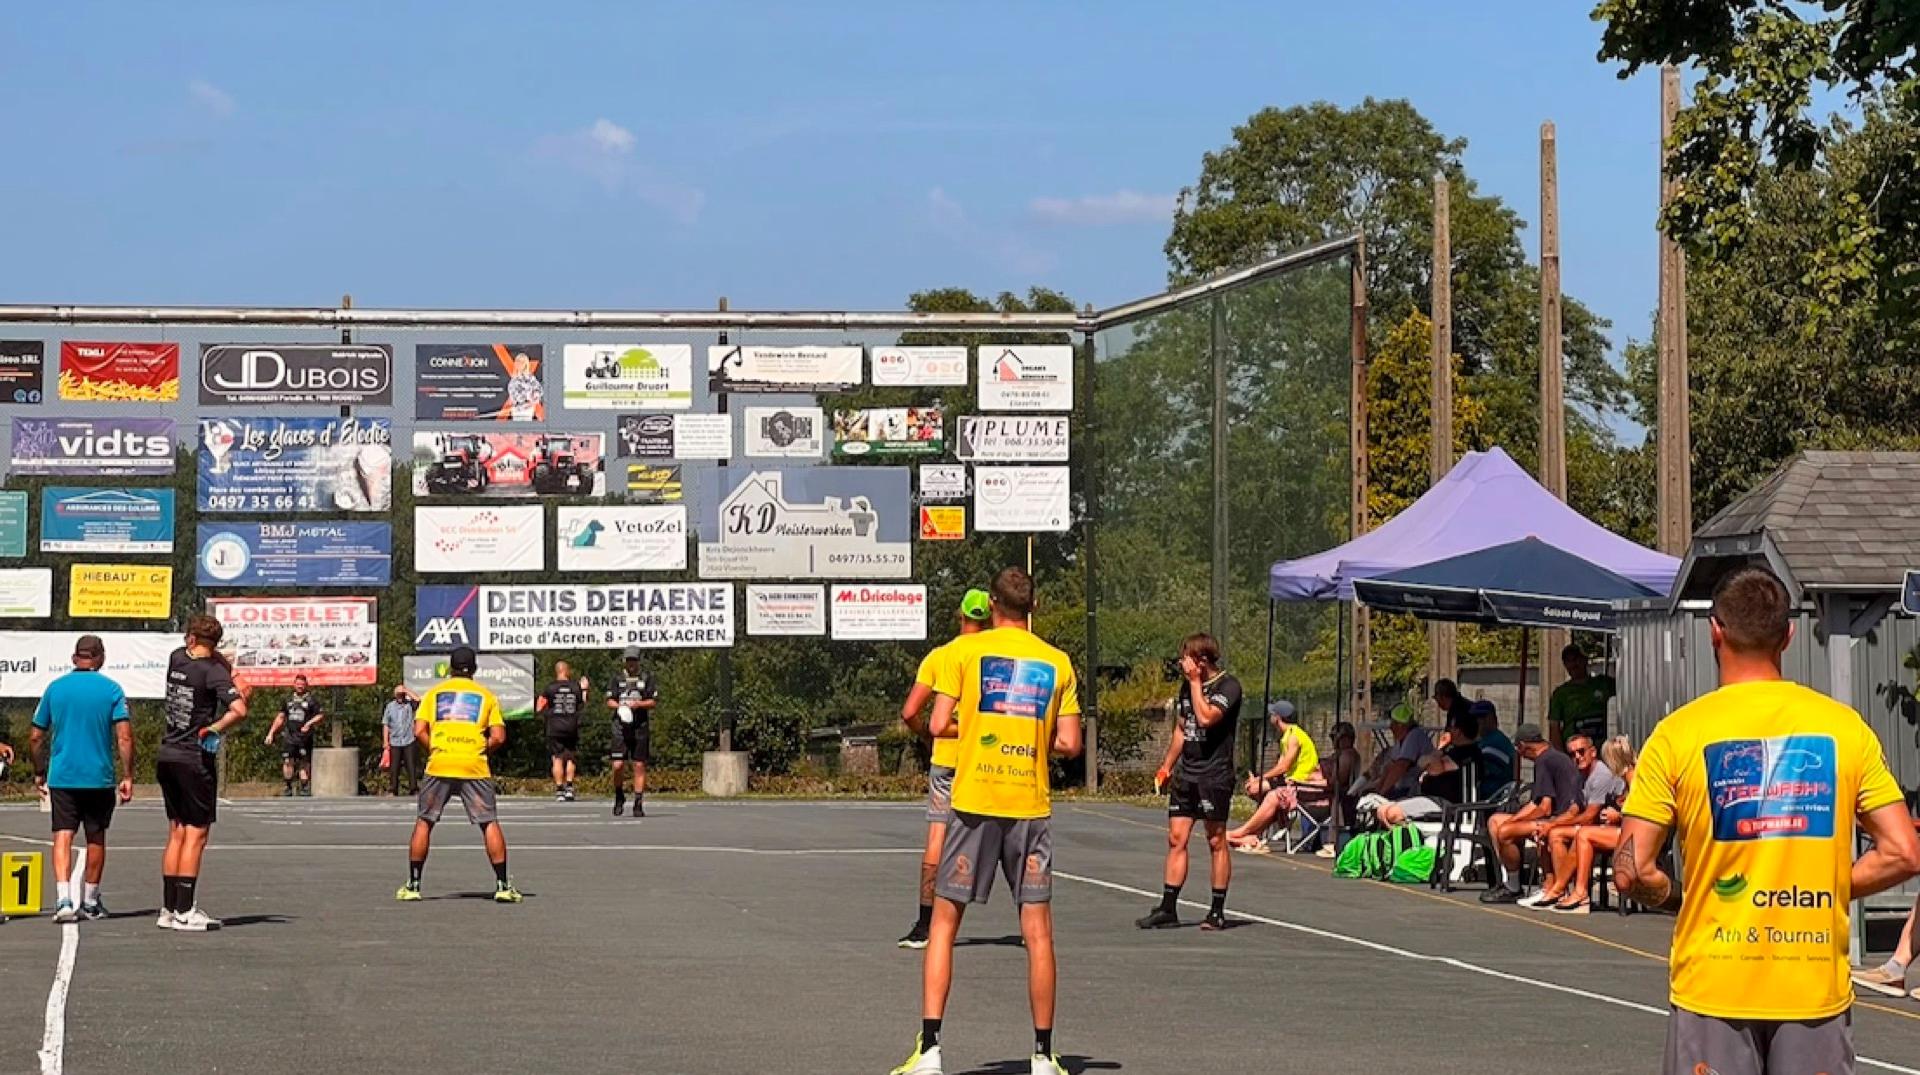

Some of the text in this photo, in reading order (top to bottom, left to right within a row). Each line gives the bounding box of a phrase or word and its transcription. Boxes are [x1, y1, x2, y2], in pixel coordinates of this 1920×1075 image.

[58, 429, 170, 457] vidts
[240, 423, 265, 451] Les
[263, 422, 317, 460] glaces
[208, 495, 316, 508] 0497 35 66 41
[487, 588, 726, 613] DENIS DEHAENE
[223, 606, 360, 622] LOISELET
[489, 615, 627, 629] BANQUE-ASSURANCE
[637, 614, 725, 626] 068/33.74.04
[415, 617, 469, 645] AXA
[489, 631, 533, 645] Place
[536, 630, 601, 646] d'Acren,
[604, 629, 615, 643] 8
[1001, 743, 1037, 758] crela
[11, 864, 29, 905] 1
[1752, 884, 1833, 909] crelan
[1712, 926, 1830, 945] Ath & Tournai
